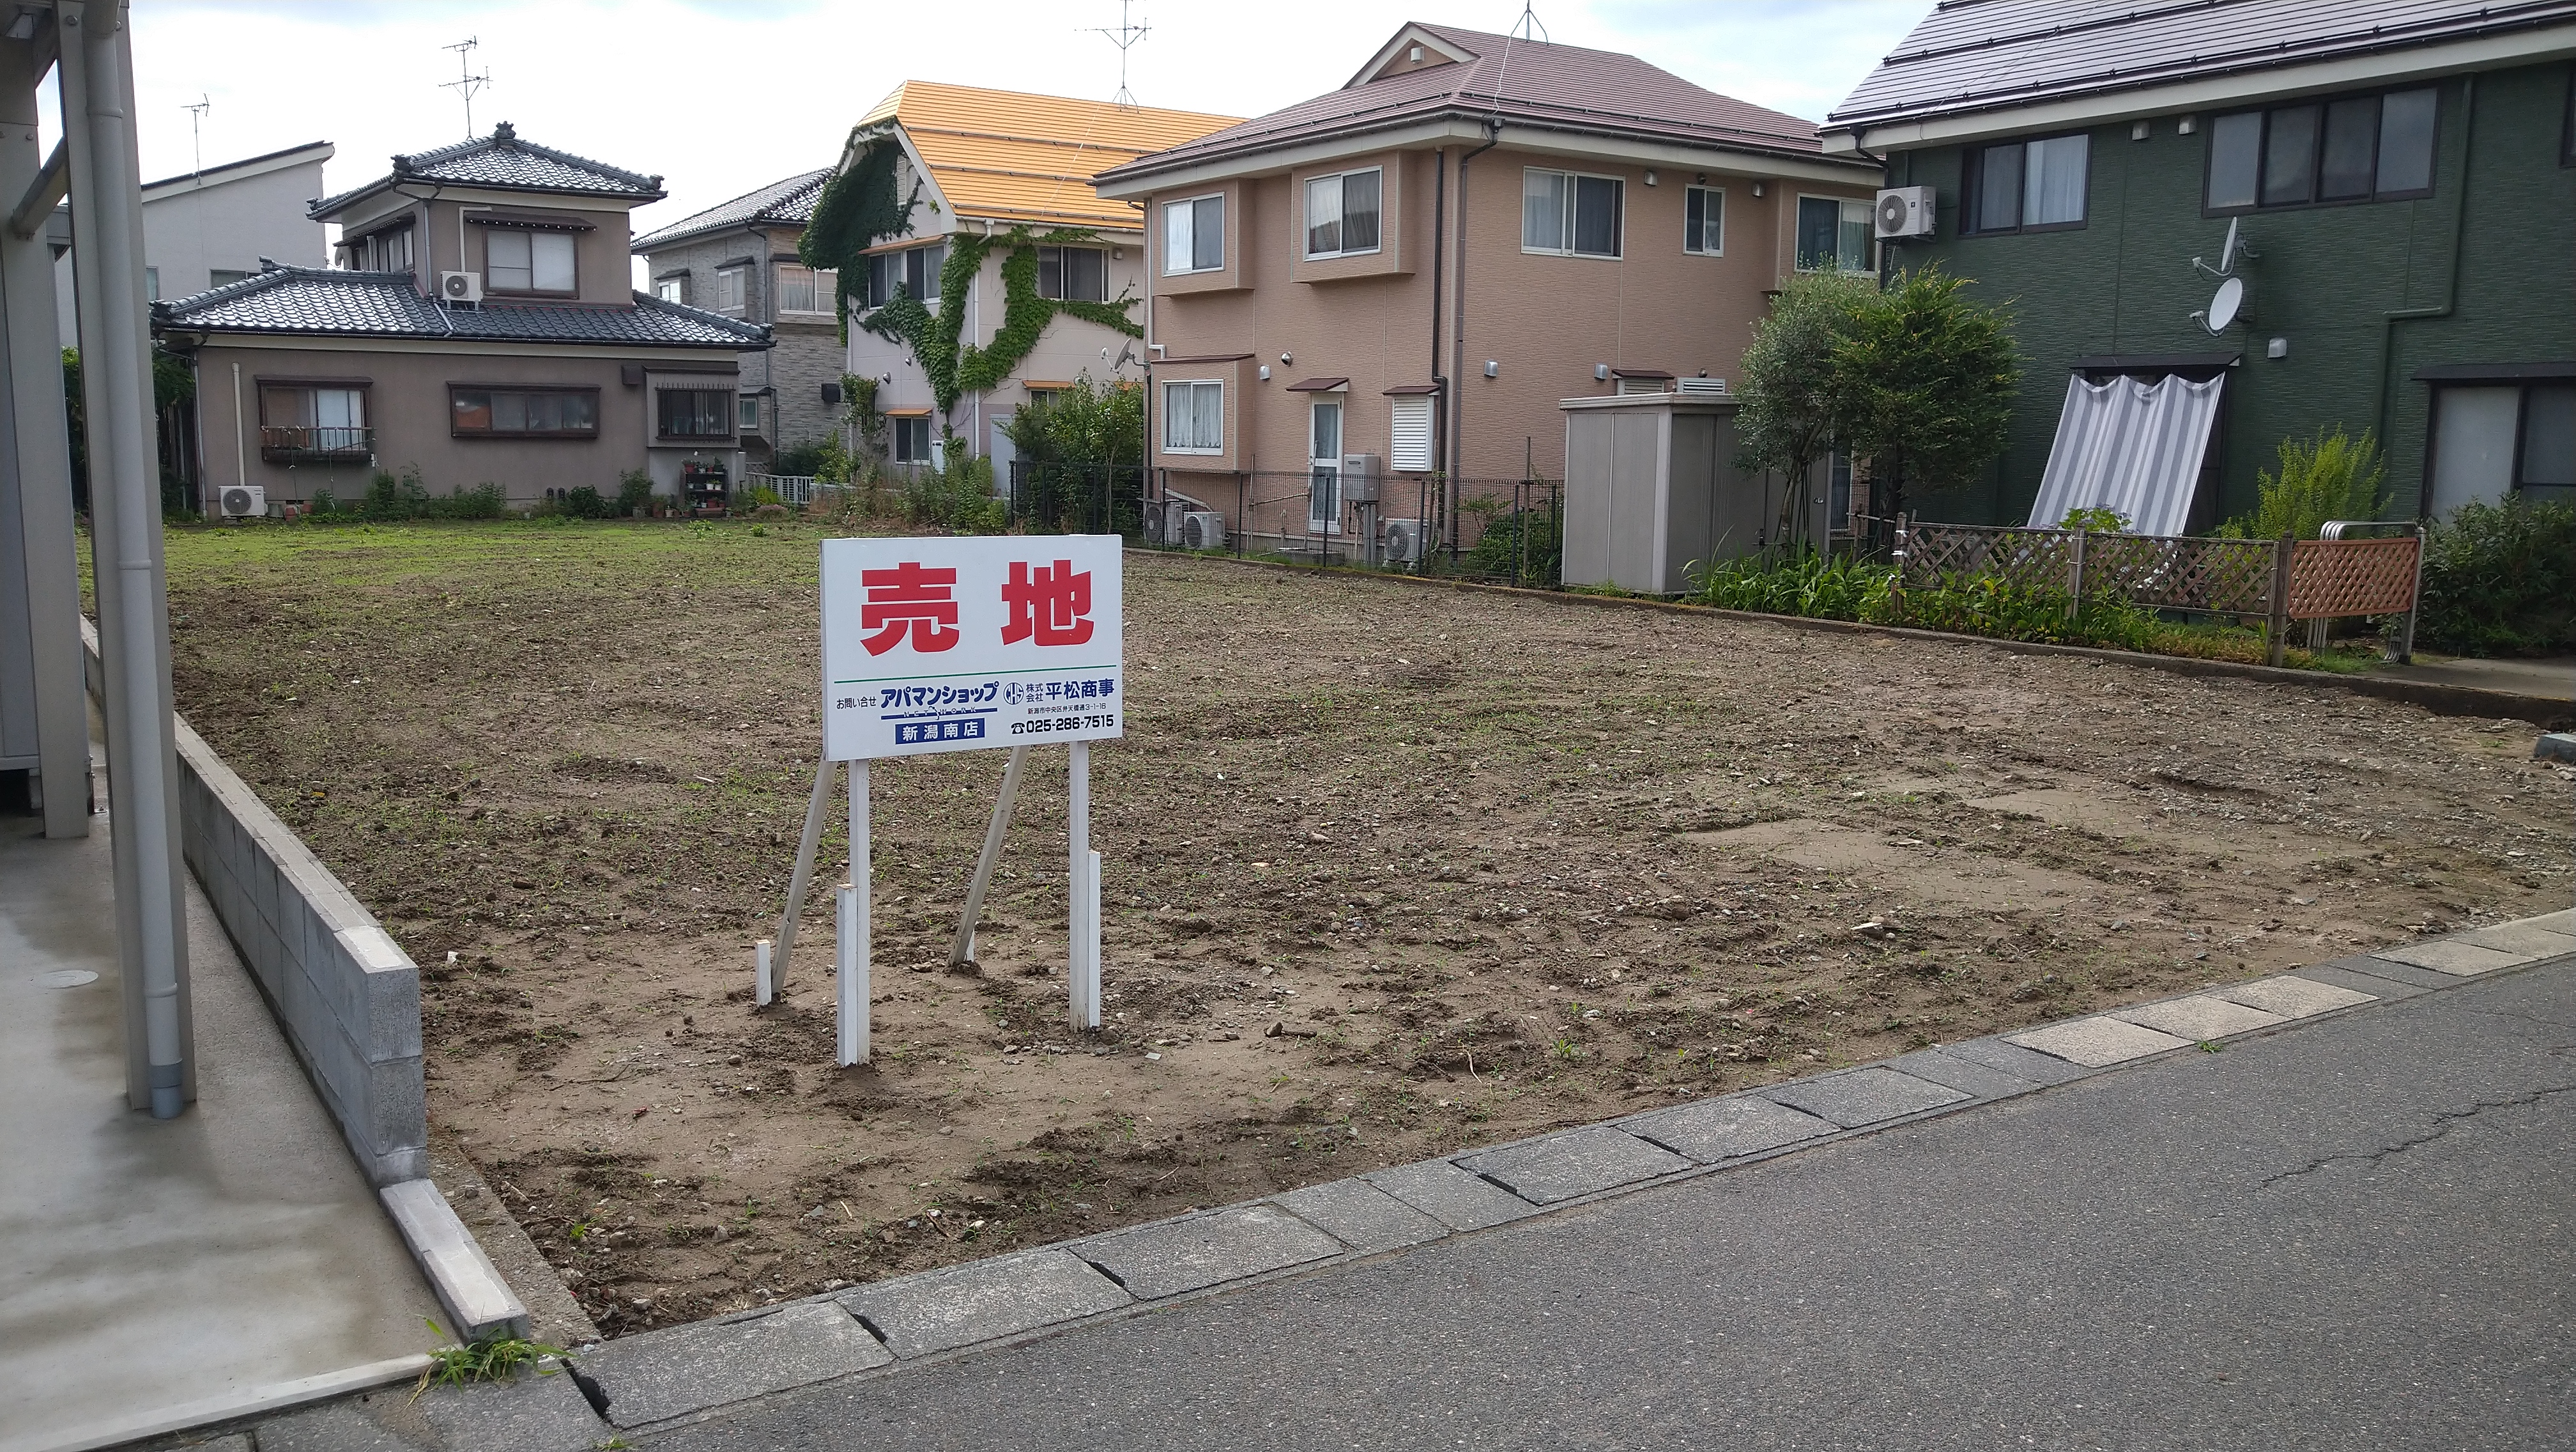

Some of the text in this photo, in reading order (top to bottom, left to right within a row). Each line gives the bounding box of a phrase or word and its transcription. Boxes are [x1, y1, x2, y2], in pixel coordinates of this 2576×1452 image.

[860, 559, 1094, 657] 売地
[880, 681, 1000, 709] アパマンショップ
[1025, 683, 1044, 693] 株式
[1025, 692, 1044, 703] 会社
[1045, 678, 1115, 701] 平松商事
[836, 696, 877, 710] お問い合せ
[902, 721, 979, 742] 新潟南店
[1026, 714, 1114, 734] 025-286-7515
